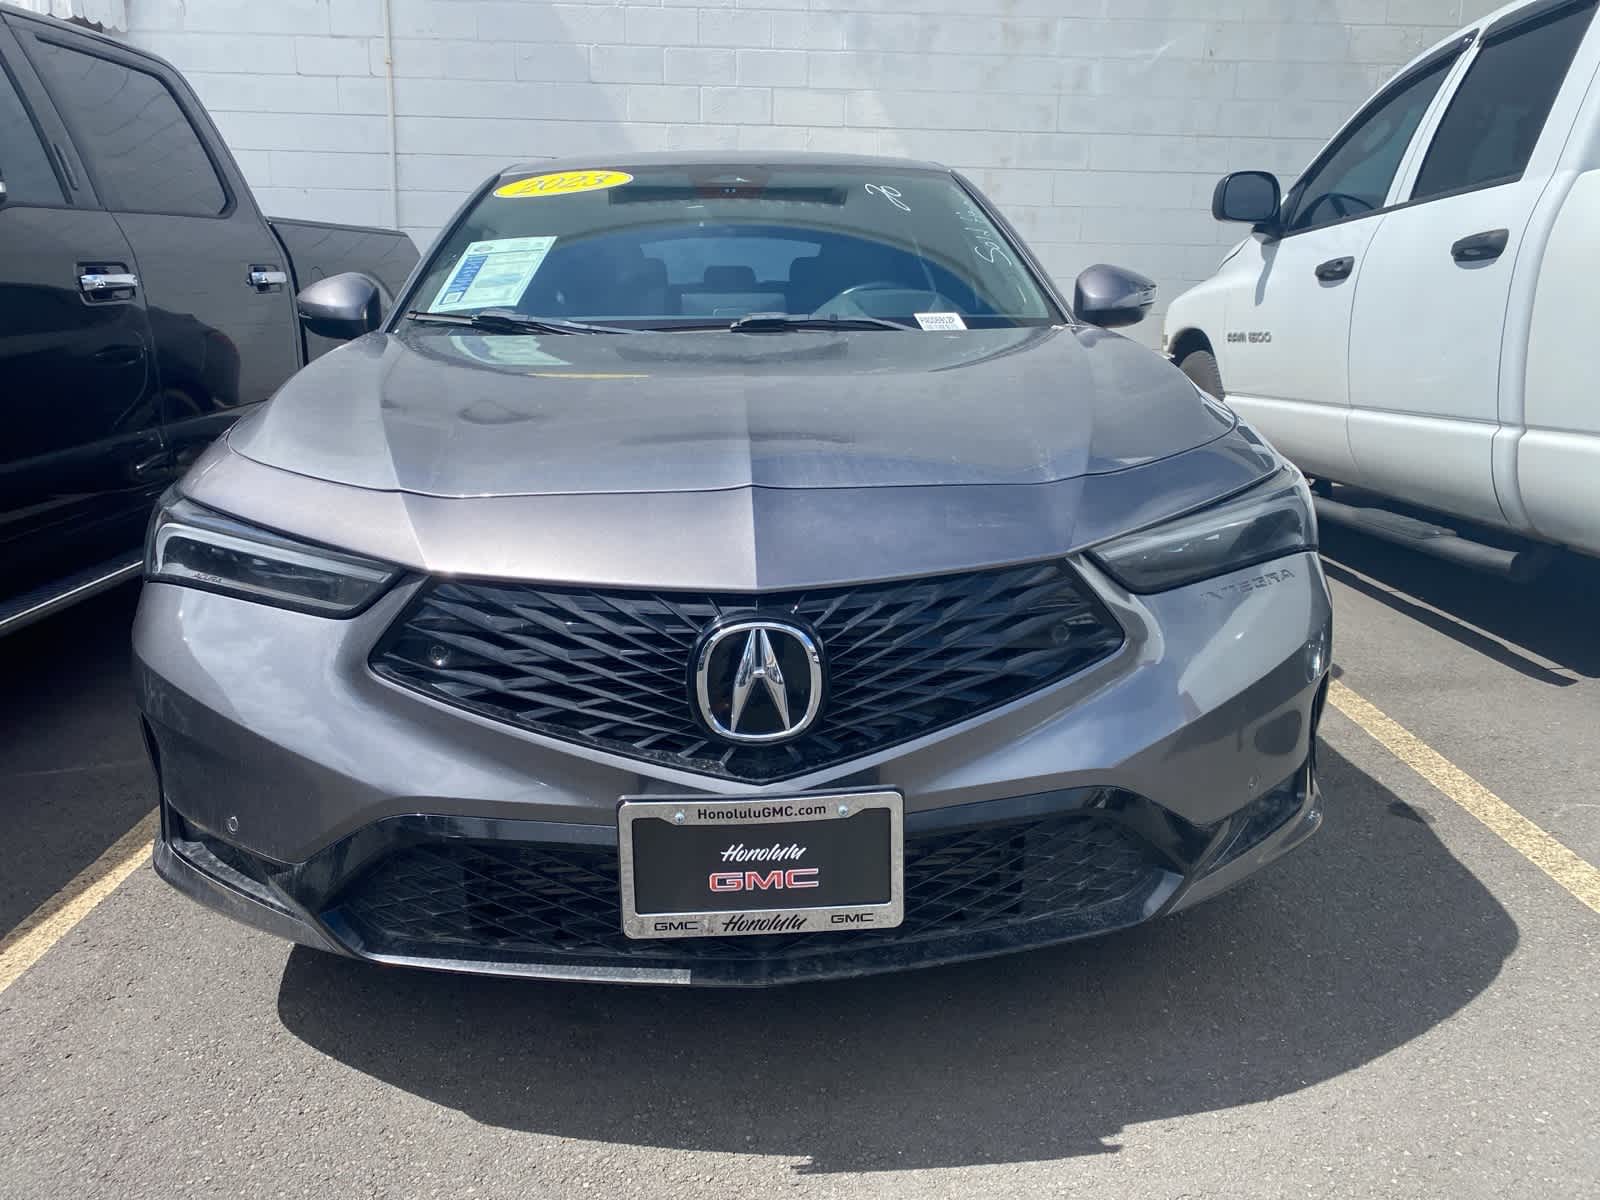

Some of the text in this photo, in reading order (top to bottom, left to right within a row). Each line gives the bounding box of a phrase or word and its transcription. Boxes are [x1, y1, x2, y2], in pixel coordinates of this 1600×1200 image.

[697, 804, 827, 821] HonoluluGMC.com
[720, 842, 807, 863] Honolulu
[708, 867, 819, 892] GMC
[653, 912, 875, 932] GMC Honolulu GMC
